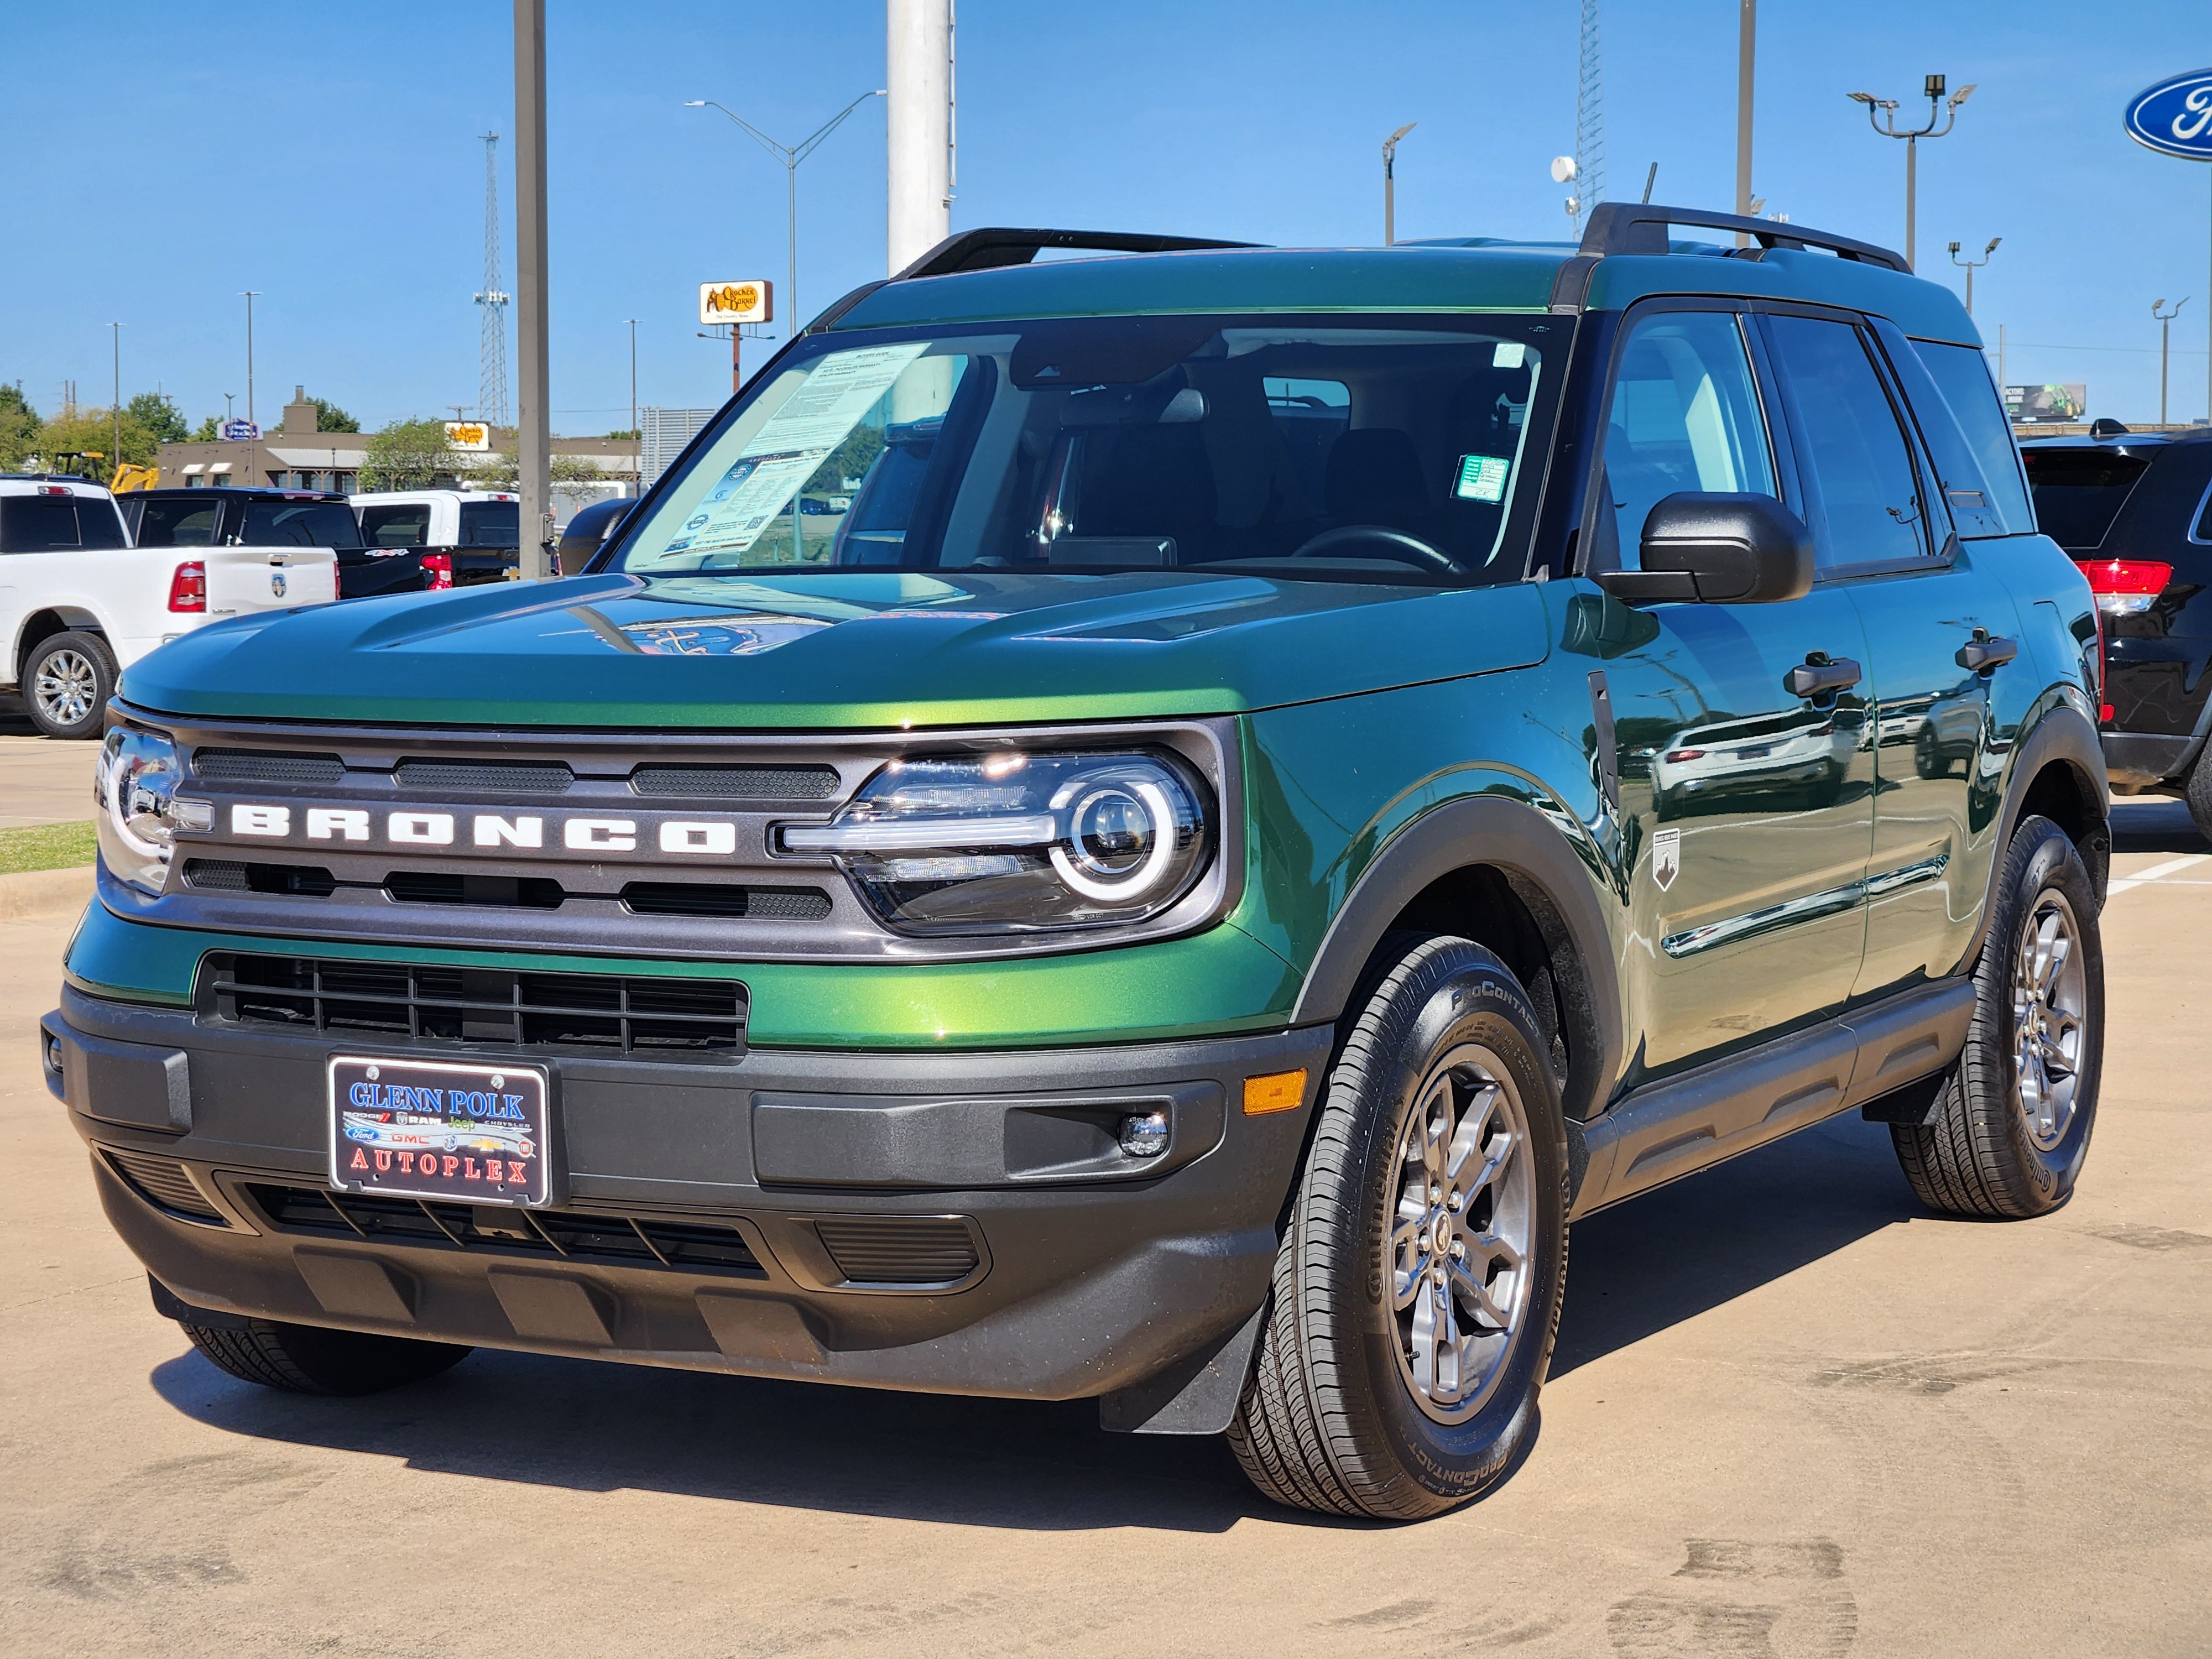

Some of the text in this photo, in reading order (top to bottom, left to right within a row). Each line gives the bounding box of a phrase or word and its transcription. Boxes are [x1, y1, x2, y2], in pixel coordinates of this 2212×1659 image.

[723, 286, 754, 300] Cracker
[730, 296, 756, 311] Barrel
[231, 804, 736, 854] BRONCO
[349, 1082, 525, 1120] GLENN POLK
[343, 1110, 383, 1120] DODGE
[409, 1116, 442, 1125] RAM
[448, 1116, 475, 1132] Jeep
[484, 1120, 531, 1128] CHRYSLER
[352, 1129, 374, 1139] Ford
[392, 1133, 430, 1145] GMC
[350, 1146, 528, 1184] AUTOPLEX
